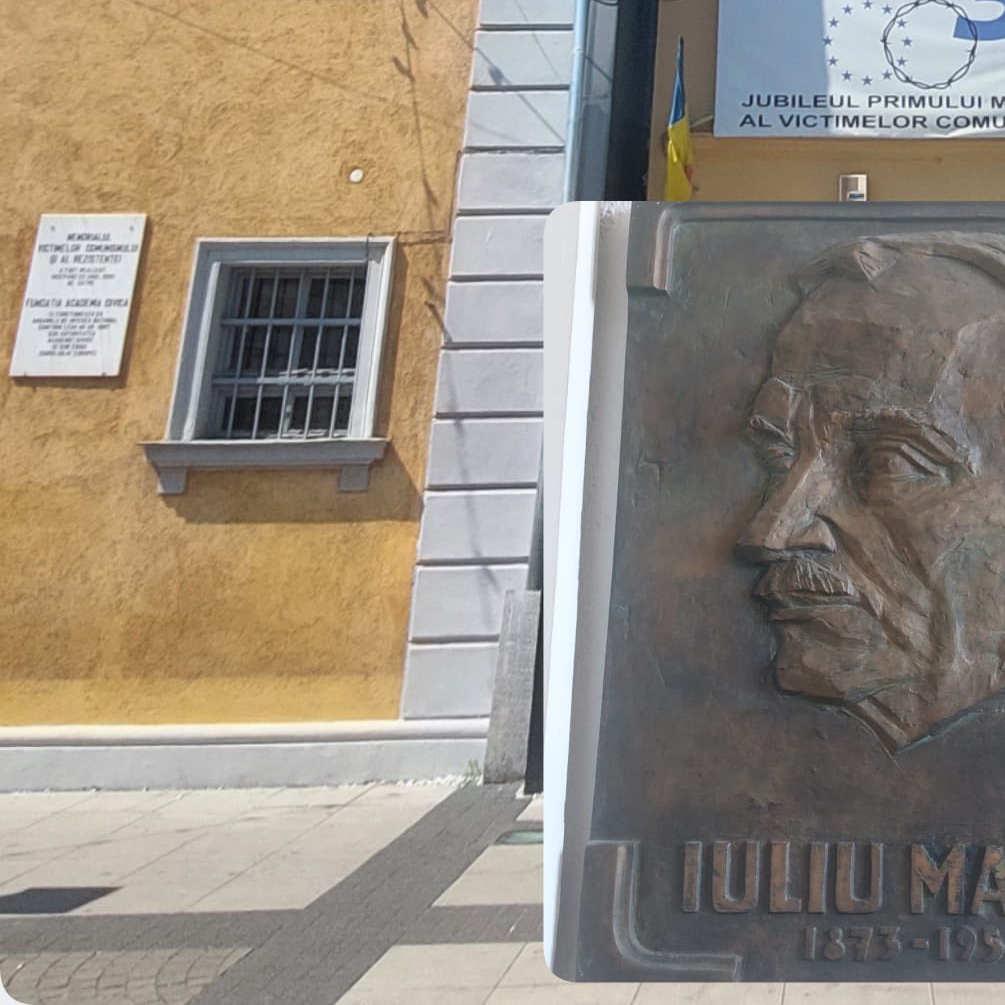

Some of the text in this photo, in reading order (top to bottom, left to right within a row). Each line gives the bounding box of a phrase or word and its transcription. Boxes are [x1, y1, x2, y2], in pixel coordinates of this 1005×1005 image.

[741, 93, 860, 109] JUBILEUL
[867, 94, 983, 109] PRIMULUI
[739, 113, 772, 128] AL
[778, 113, 928, 129] VICTIMELOR
[682, 840, 885, 915] IULIU
